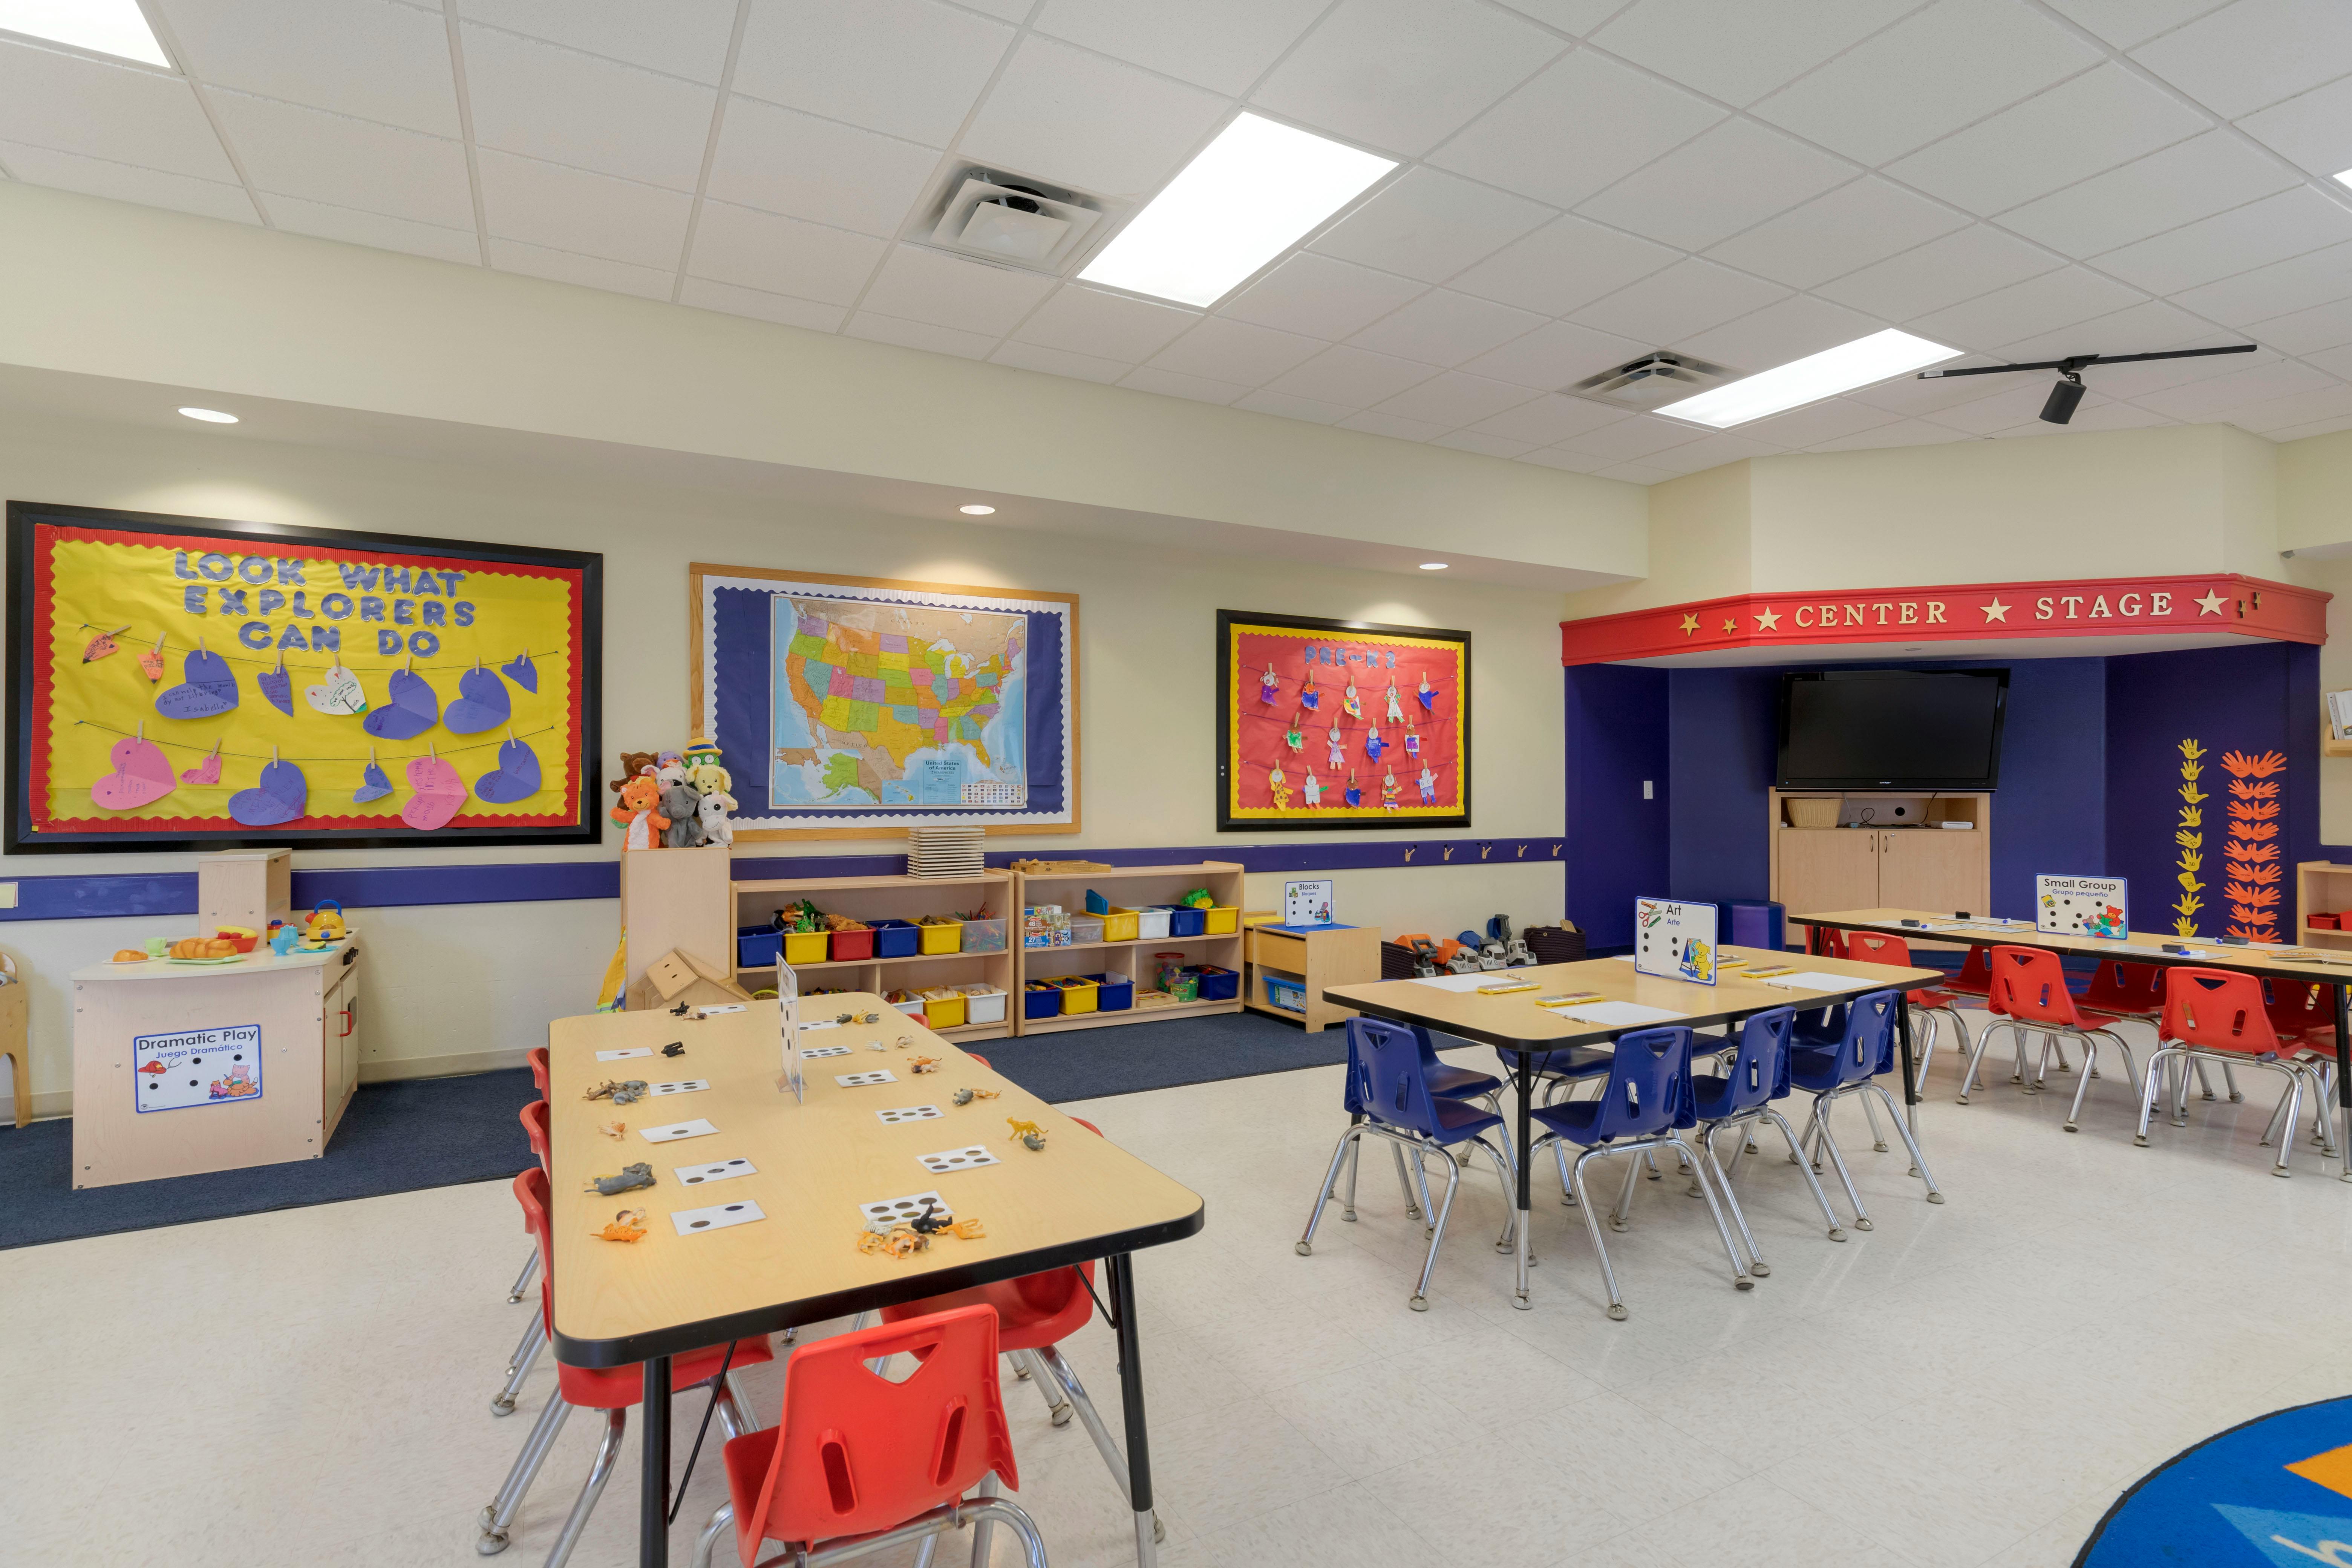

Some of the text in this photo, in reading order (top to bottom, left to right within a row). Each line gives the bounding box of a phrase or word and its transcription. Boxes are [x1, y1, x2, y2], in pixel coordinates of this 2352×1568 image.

[175, 551, 465, 598] LOOK WHAT
[184, 585, 476, 627] EXPLORERS
[1795, 592, 2173, 627] CENTER STAGE
[238, 621, 441, 657] CAN DO
[1305, 646, 1396, 669] PRE-K 2
[2044, 878, 2116, 892] Small Group
[1666, 904, 1681, 916] Art
[139, 1030, 257, 1050] Dramatic Play
[191, 1044, 242, 1055] Dramático
